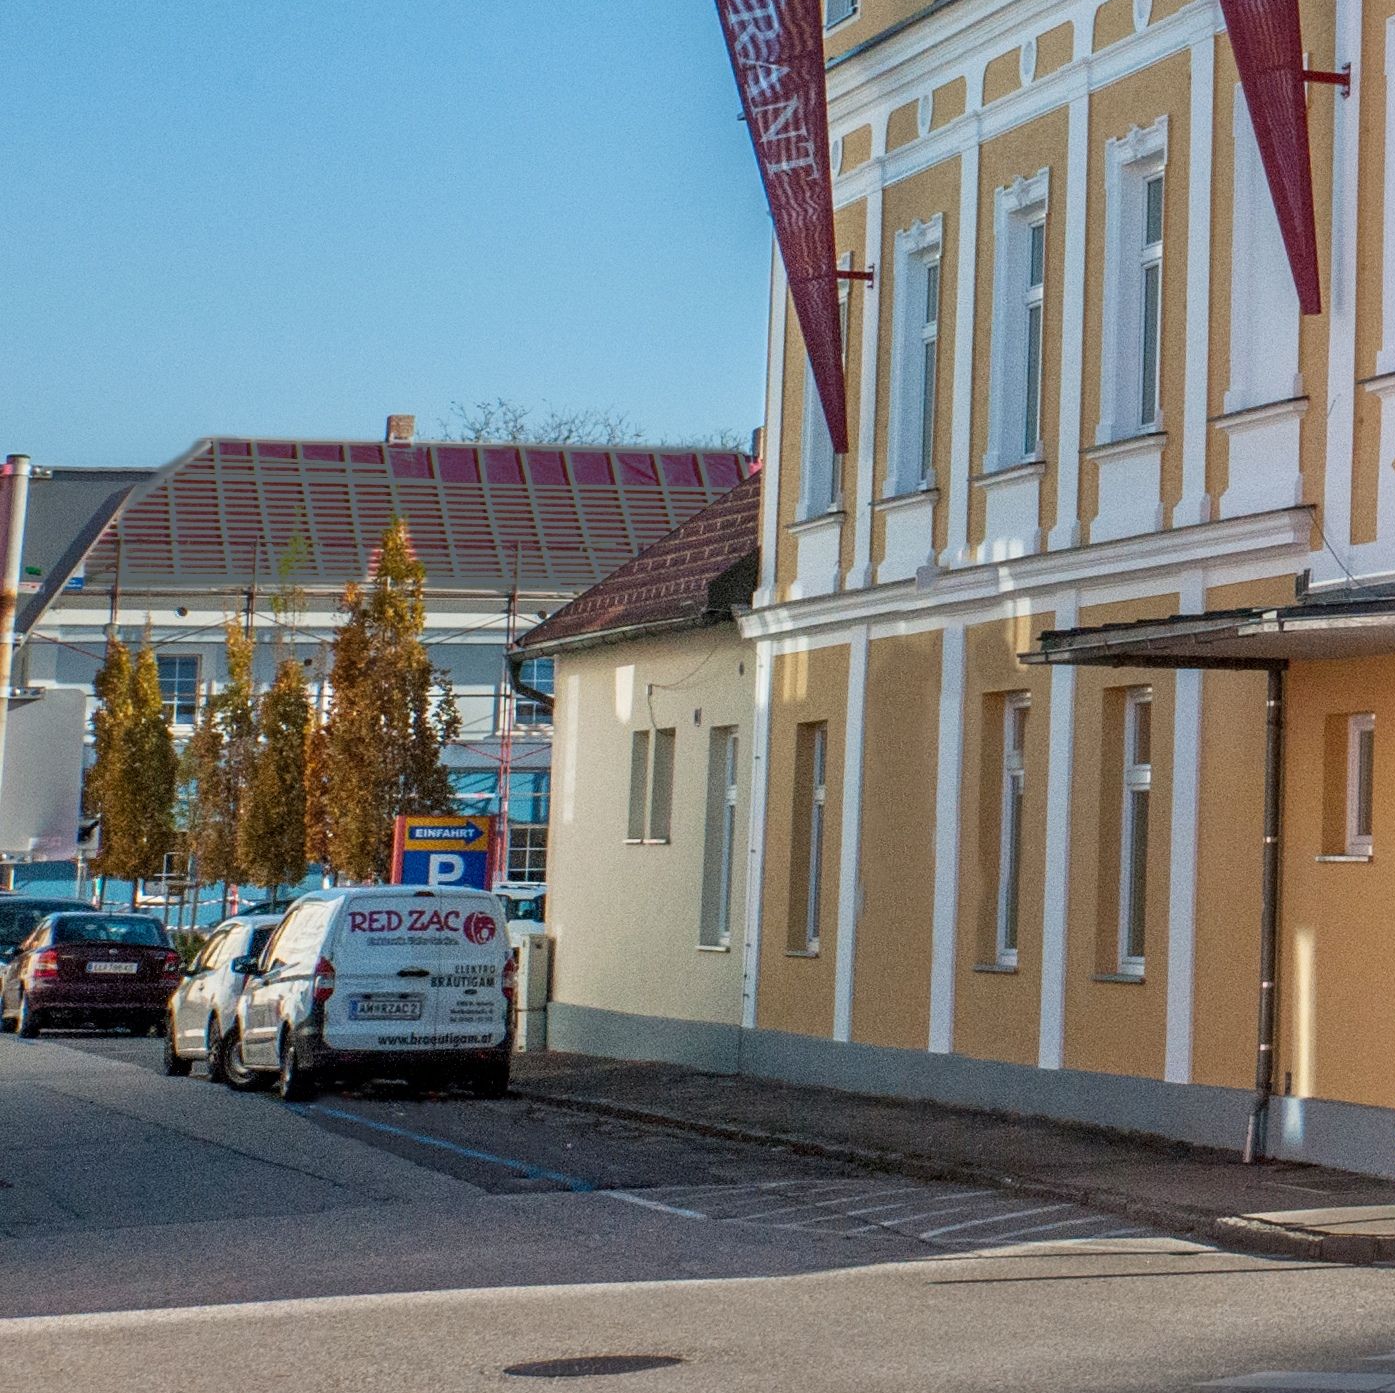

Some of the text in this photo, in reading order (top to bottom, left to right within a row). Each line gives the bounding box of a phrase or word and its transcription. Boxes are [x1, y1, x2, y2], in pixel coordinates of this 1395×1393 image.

[415, 828, 476, 838] EINFAHRT
[428, 853, 465, 887] P
[348, 909, 461, 933] RED ZAC
[455, 964, 496, 975] ELEKTRO
[377, 1031, 493, 1047] www.braeutigam.at
